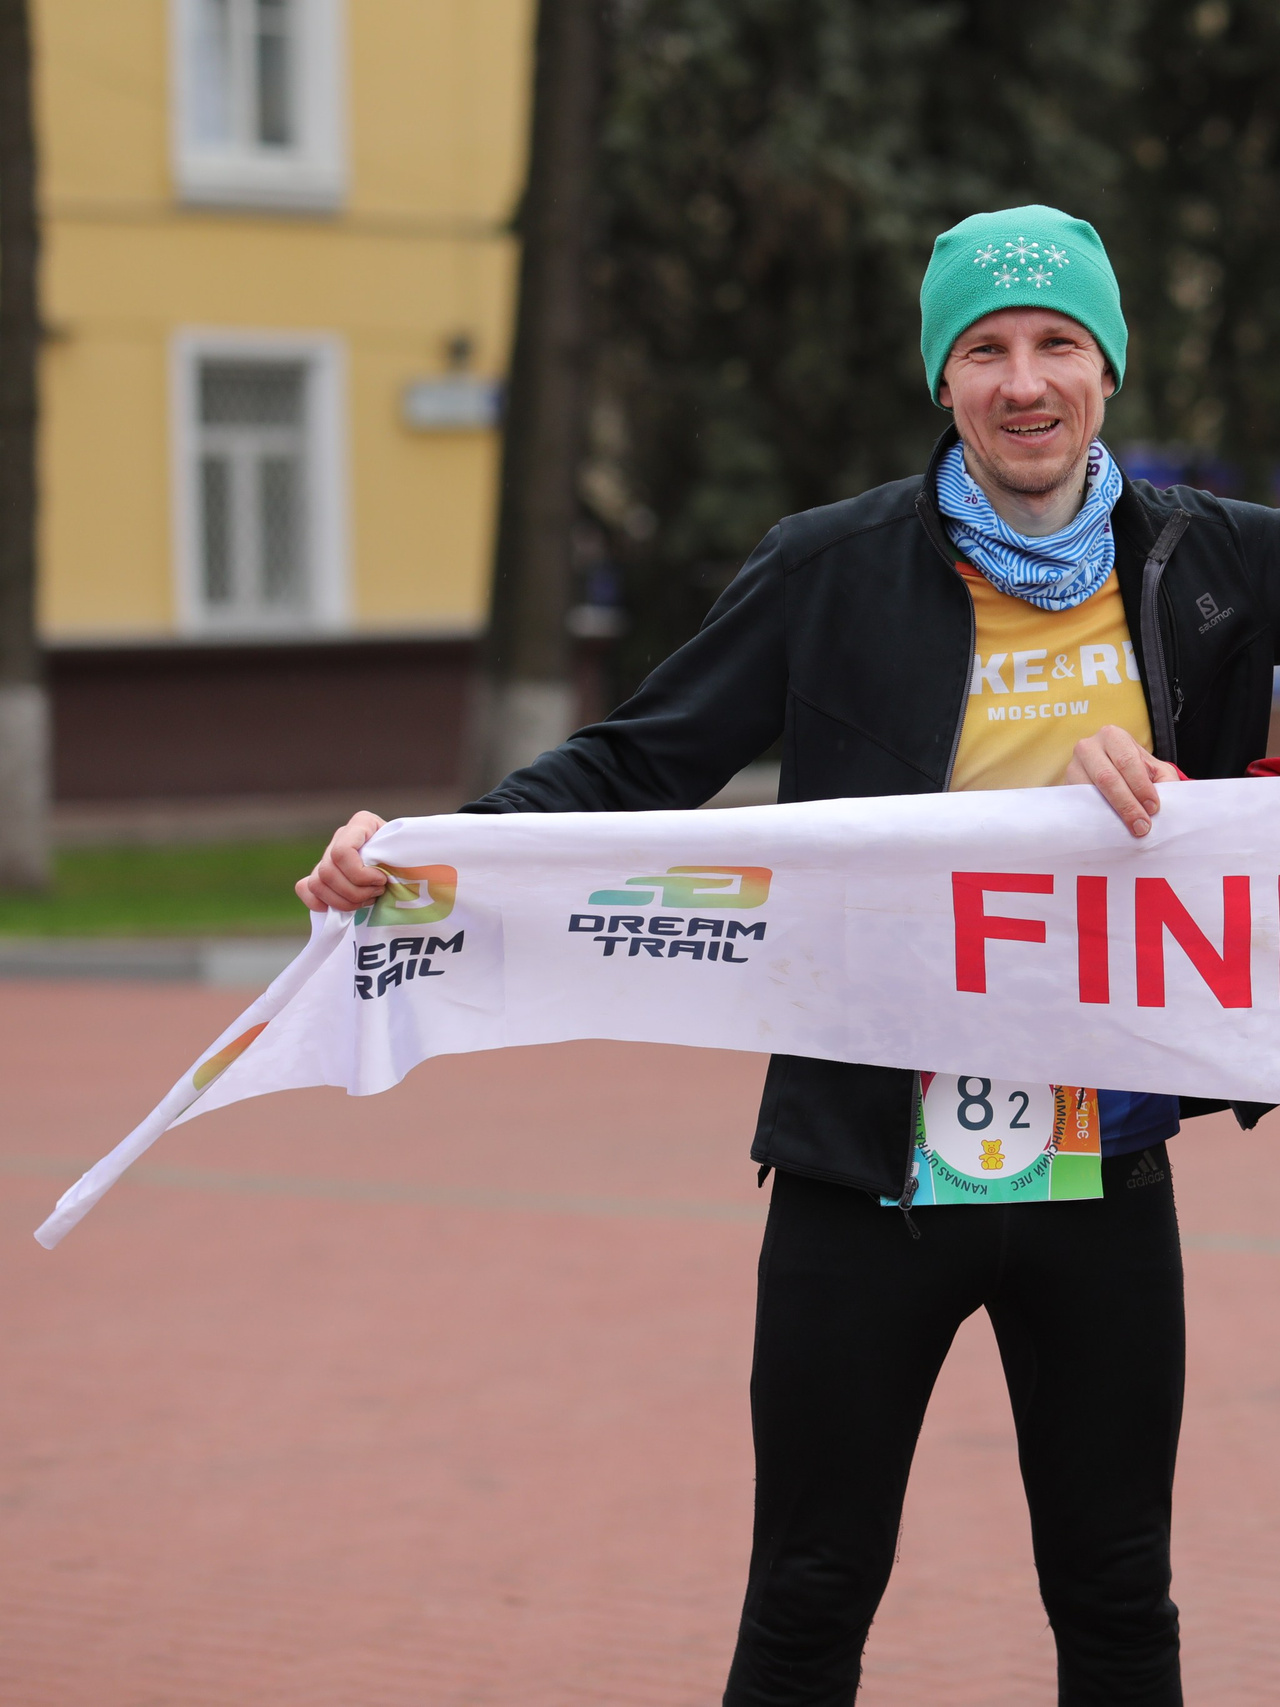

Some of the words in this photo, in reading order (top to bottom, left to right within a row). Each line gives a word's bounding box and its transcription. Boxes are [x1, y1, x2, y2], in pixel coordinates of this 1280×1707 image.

[1198, 607, 1235, 635] salomon
[988, 700, 1090, 721] MOSCOW
[568, 913, 767, 941] DREAM
[593, 936, 749, 964] TRAIL
[957, 1075, 994, 1131] 8
[1008, 1091, 1030, 1129] 2
[1033, 1085, 1067, 1177] ХИМКИНСКИЙ
[937, 1166, 988, 1196] KANNAS
[1010, 1172, 1033, 1192] ЛЕС
[1126, 1169, 1165, 1189] adidas
